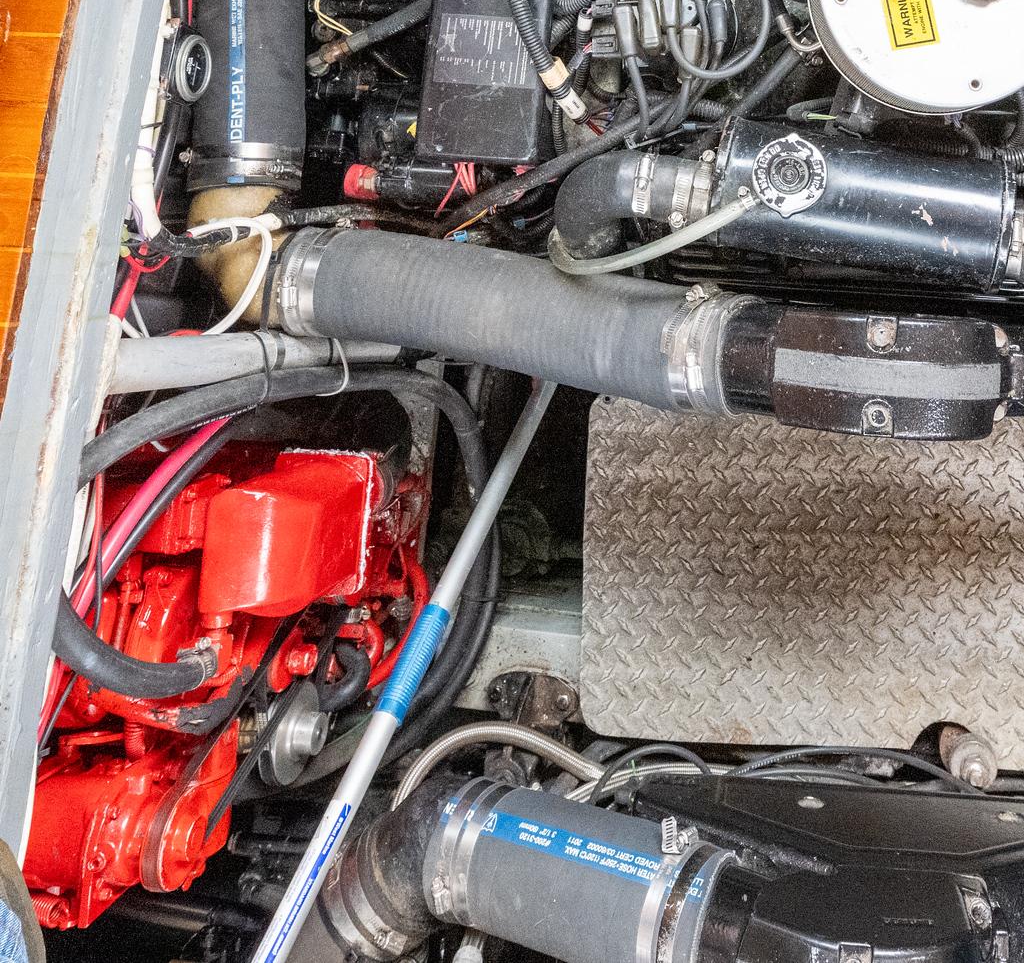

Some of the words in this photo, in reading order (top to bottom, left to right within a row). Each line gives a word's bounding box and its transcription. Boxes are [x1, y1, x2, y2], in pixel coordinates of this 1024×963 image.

[910, 1, 919, 24] ATTEMPT
[919, 15, 927, 34] ENGINE
[230, 66, 244, 162] IDENT-PLY
[519, 832, 552, 848] #200-3120
[567, 836, 583, 846] 2011
[614, 851, 635, 863] CERT
[637, 868, 659, 881] ATER
